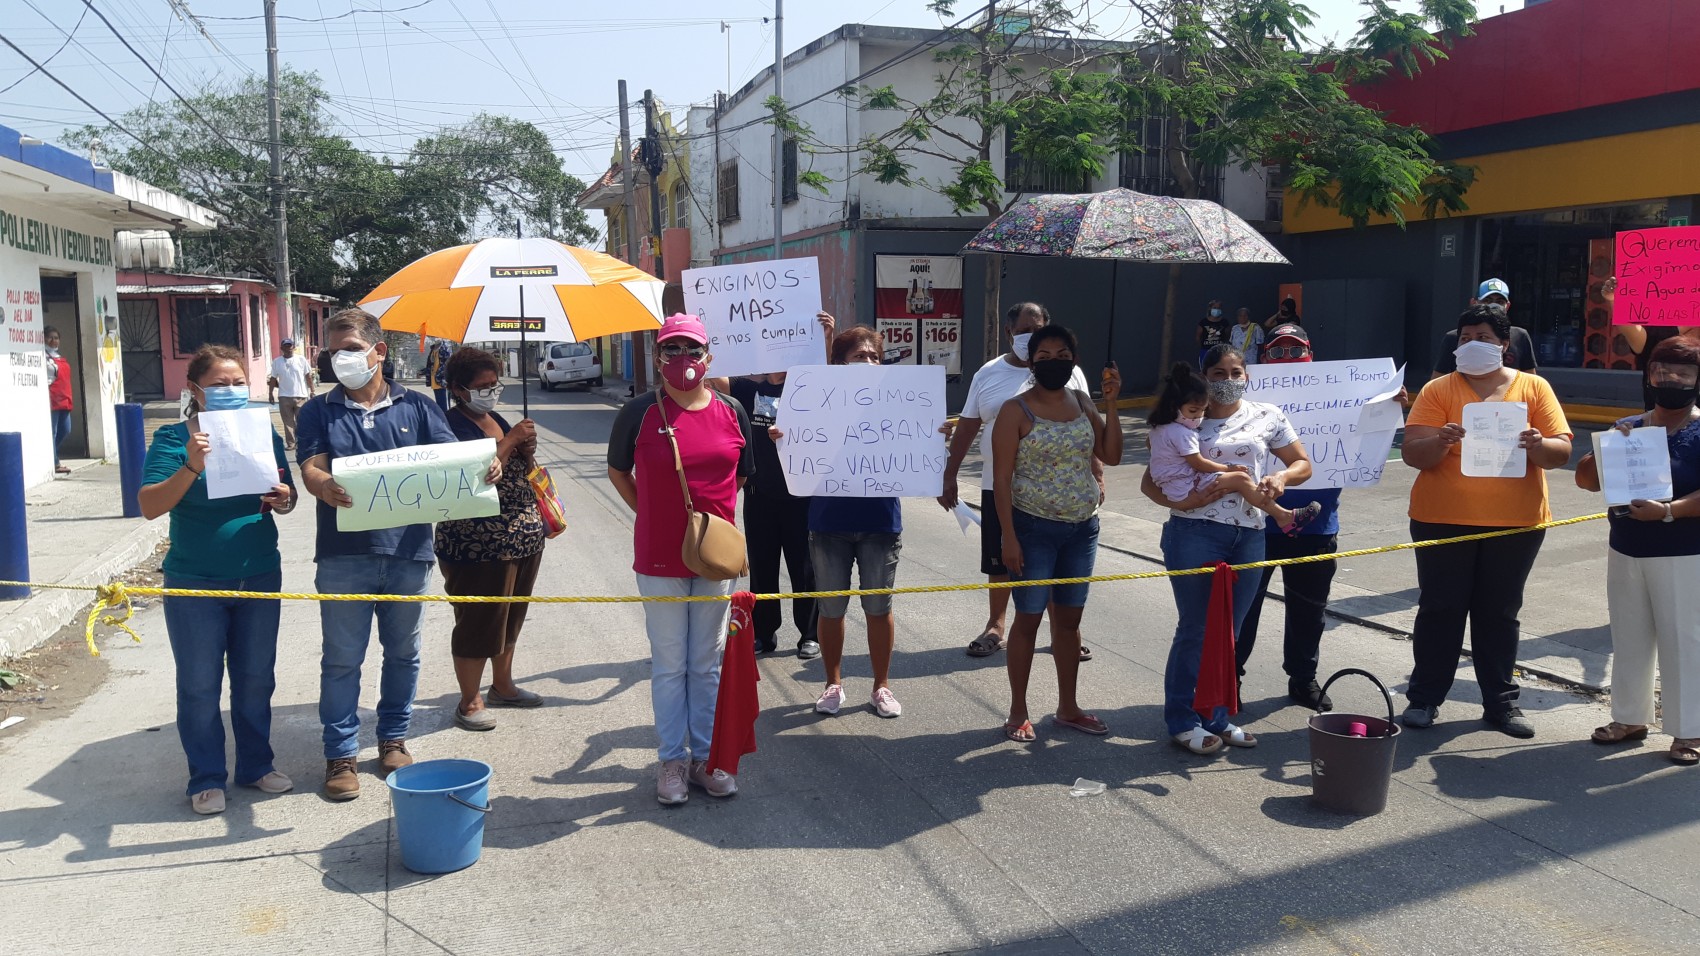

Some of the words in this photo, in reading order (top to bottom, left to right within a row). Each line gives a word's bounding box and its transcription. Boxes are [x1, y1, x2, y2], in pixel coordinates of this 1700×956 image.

[0, 209, 52, 257] POLLERIA
[52, 225, 59, 258] Y
[60, 228, 113, 267] VERDULERIA
[1445, 238, 1453, 250] E
[1621, 231, 1700, 258] Querem
[1620, 260, 1700, 280] Exigimo
[6, 288, 21, 304] POLLO
[1619, 282, 1640, 296] de
[1645, 280, 1686, 301] Agua
[729, 298, 785, 323] MASS
[1628, 301, 1651, 321] NO
[9, 328, 25, 343] TODOS
[727, 332, 751, 345] nos
[880, 327, 914, 343] $156
[925, 327, 958, 343] $166
[1325, 373, 1342, 384] EL
[1346, 365, 1390, 383] PRONTO
[789, 371, 933, 412] EXIGIMOS
[787, 427, 829, 447] NOS
[843, 418, 934, 446] ABRAN
[344, 449, 440, 468] QUEREMOS
[788, 453, 835, 476] LAS
[846, 451, 943, 476] VALVULAS
[367, 467, 474, 513] AGUA
[825, 479, 851, 494] DE
[863, 477, 904, 496] PASO
